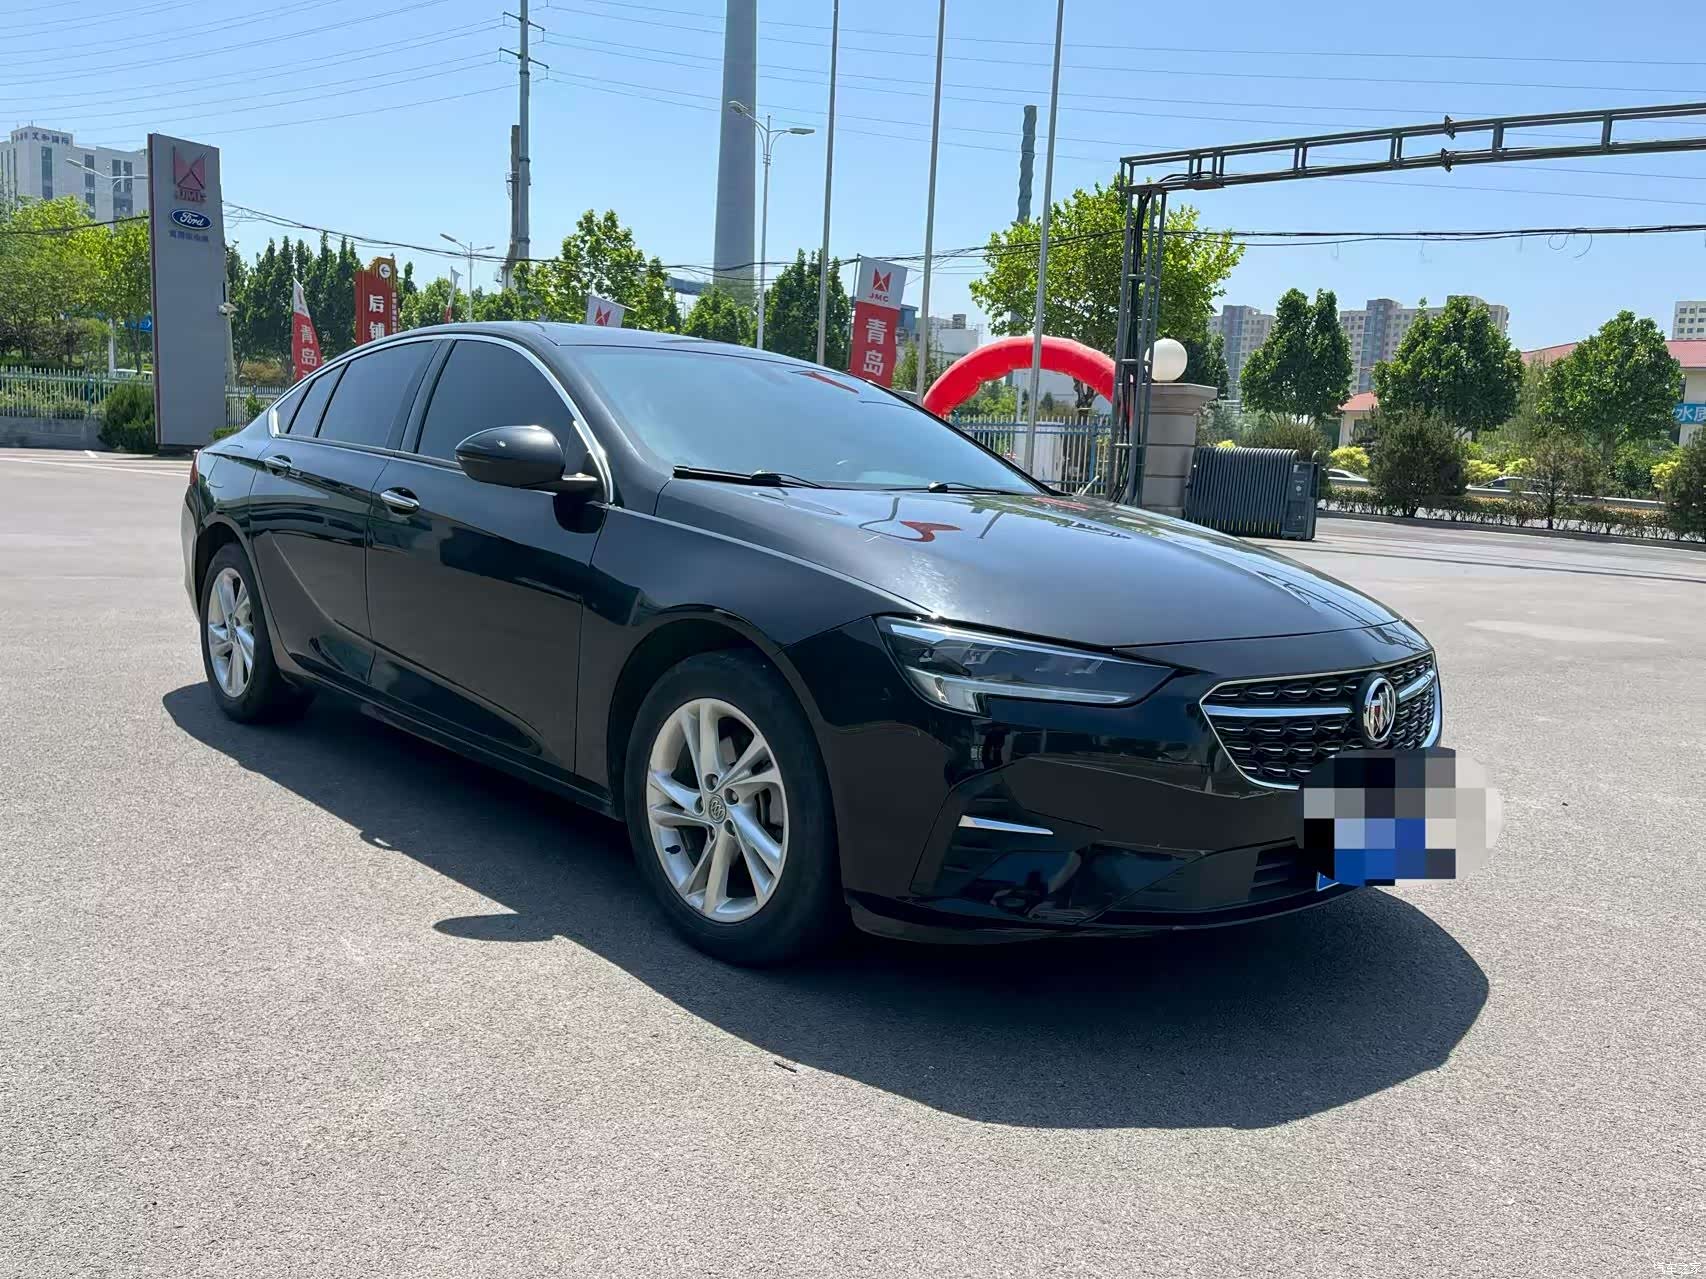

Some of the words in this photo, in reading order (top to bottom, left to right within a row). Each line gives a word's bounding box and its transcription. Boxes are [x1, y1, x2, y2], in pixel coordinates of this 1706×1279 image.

[180, 211, 205, 227] Ford
[869, 292, 889, 302] JMC
[300, 324, 317, 377] 青岛
[864, 318, 887, 376] 青岛
